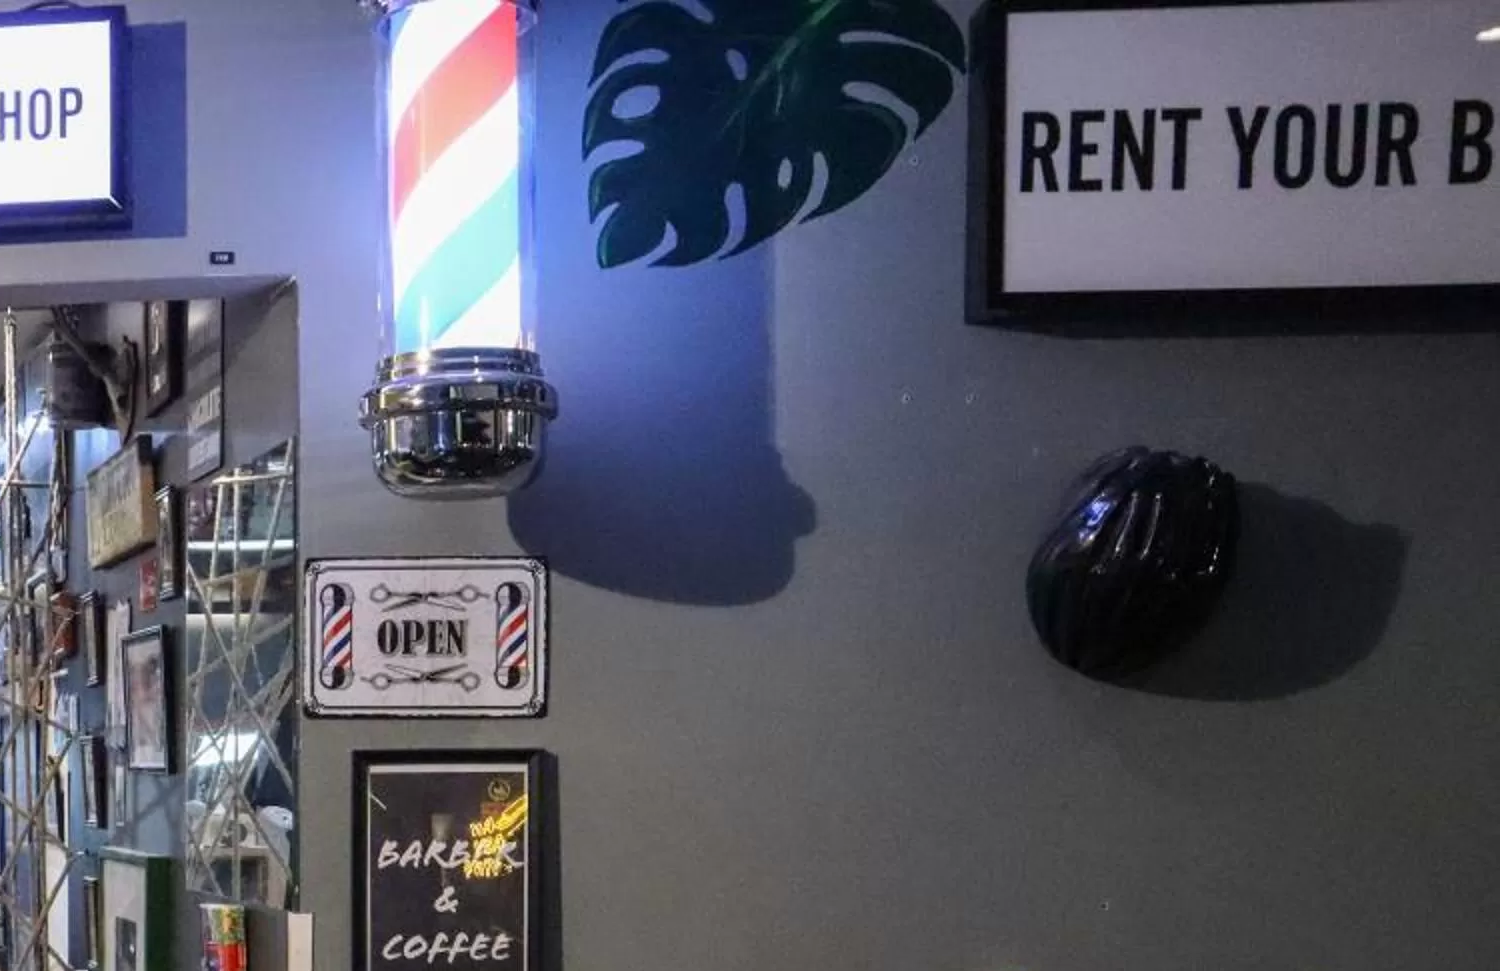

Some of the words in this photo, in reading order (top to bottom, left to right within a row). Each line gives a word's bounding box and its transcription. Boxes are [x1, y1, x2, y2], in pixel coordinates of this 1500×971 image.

[1019, 107, 1202, 193] RENT
[1225, 101, 1420, 190] YOUR
[1447, 98, 1494, 184] B
[377, 618, 471, 657] OPEN
[433, 885, 461, 914] &
[381, 931, 515, 965] COFFEE
